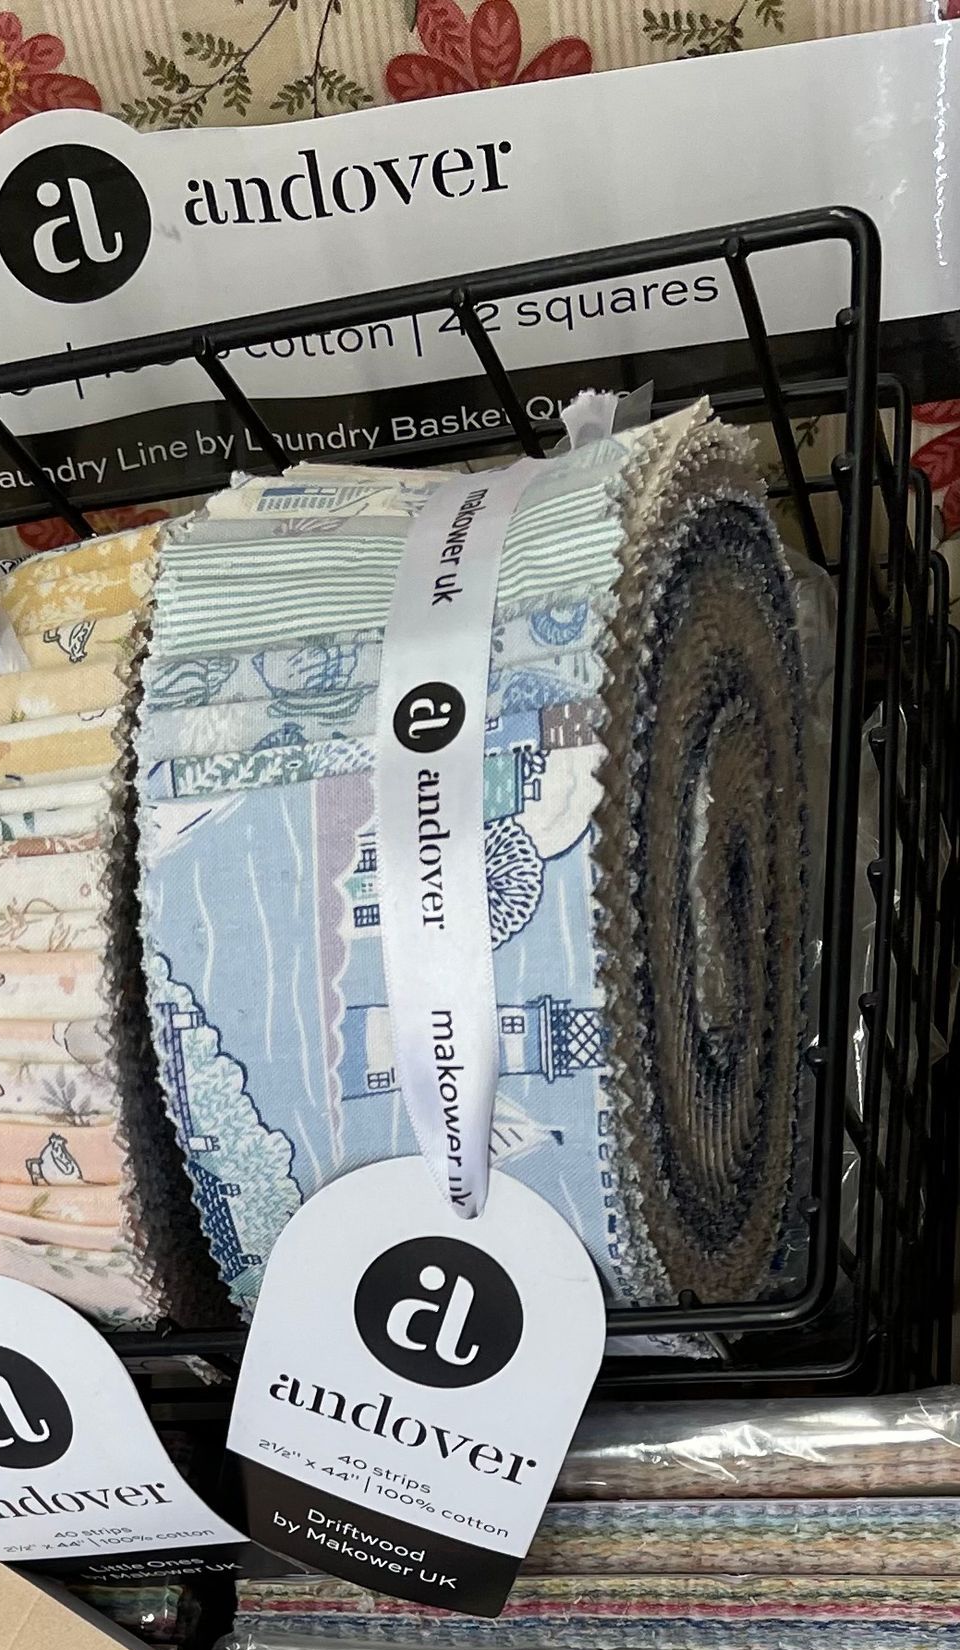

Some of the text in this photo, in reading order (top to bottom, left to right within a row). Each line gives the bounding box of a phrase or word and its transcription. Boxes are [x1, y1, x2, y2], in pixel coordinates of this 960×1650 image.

[183, 138, 514, 228] andover
[516, 274, 720, 331] squares
[117, 440, 188, 471] Line
[196, 430, 235, 459] by
[431, 487, 489, 606] makower uk
[416, 768, 451, 931] andover
[268, 1373, 537, 1486] andover
[305, 1458, 317, 1470] x
[321, 1465, 360, 1482] 44"
[375, 1484, 436, 1514] 100%
[441, 1508, 509, 1539] cotton
[337, 1454, 432, 1495] 40 strips
[53, 1526, 133, 1539] 40 strips
[57, 1539, 84, 1548] 44"
[100, 1534, 153, 1545] 100%
[156, 1528, 215, 1540] cotton
[272, 1511, 460, 1590] by Makower UK
[306, 1507, 427, 1563] Driftwood
[88, 1557, 205, 1573] Little Ones
[109, 1566, 203, 1581] Makower
[206, 1561, 243, 1573] UK
